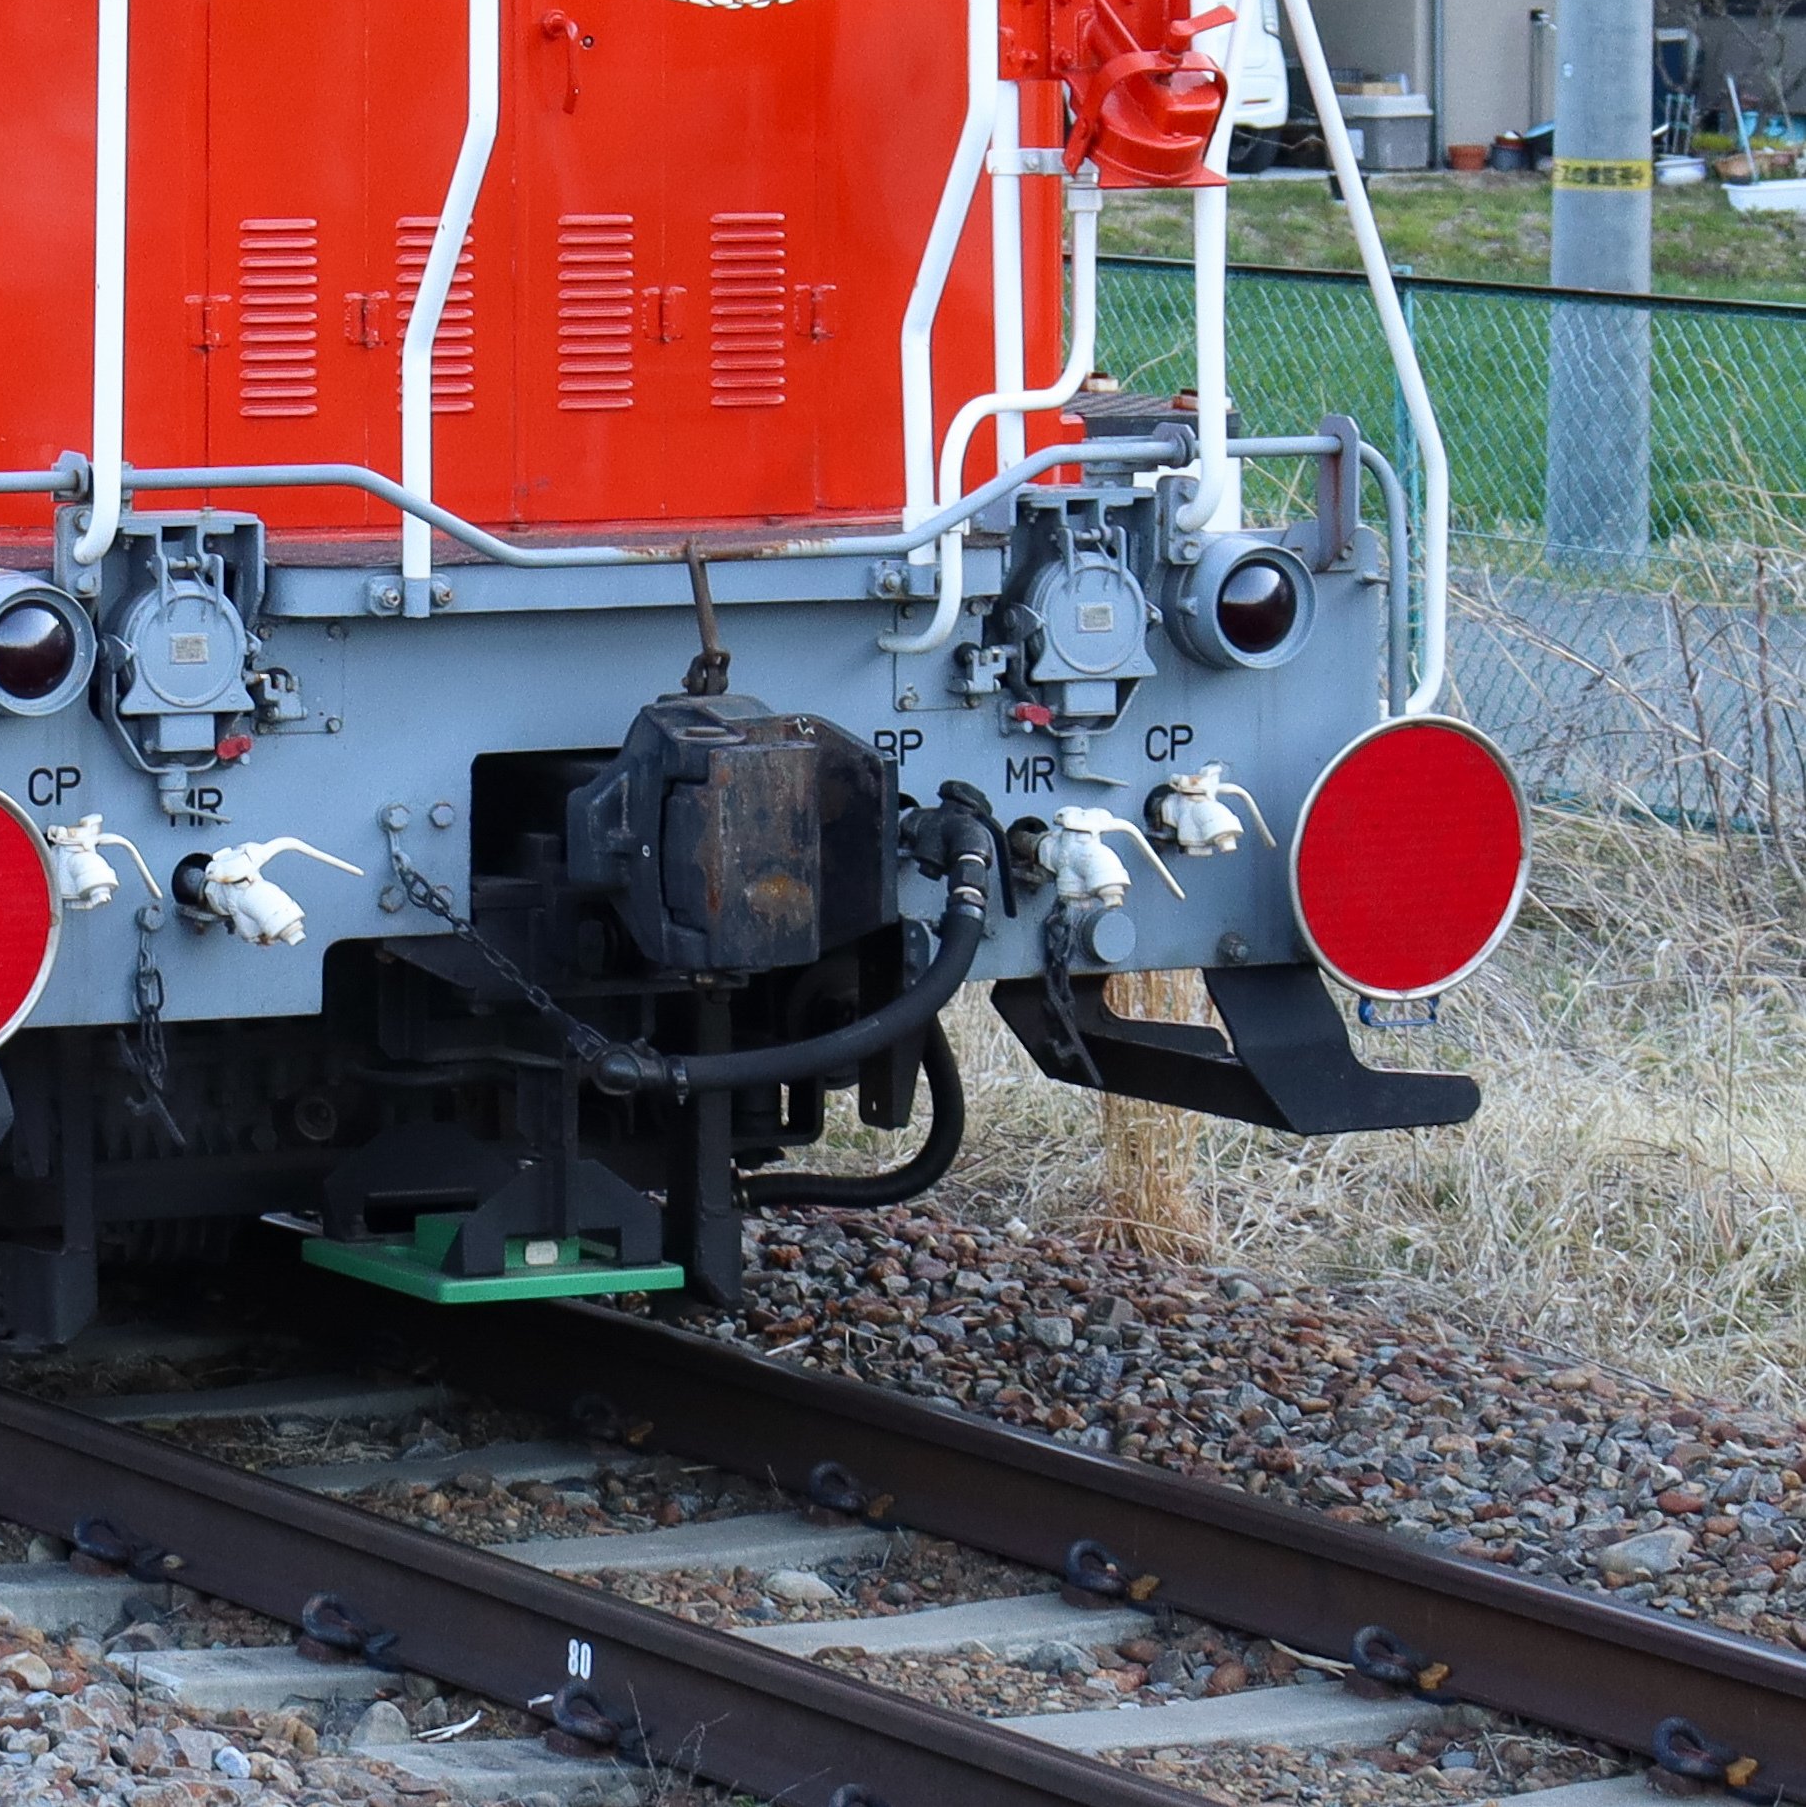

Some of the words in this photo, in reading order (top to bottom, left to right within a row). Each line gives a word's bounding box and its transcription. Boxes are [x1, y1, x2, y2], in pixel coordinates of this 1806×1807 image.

[1144, 724, 1195, 762] CP
[28, 765, 82, 807] CP
[1005, 755, 1056, 795] MR
[567, 1638, 592, 1680] 80
